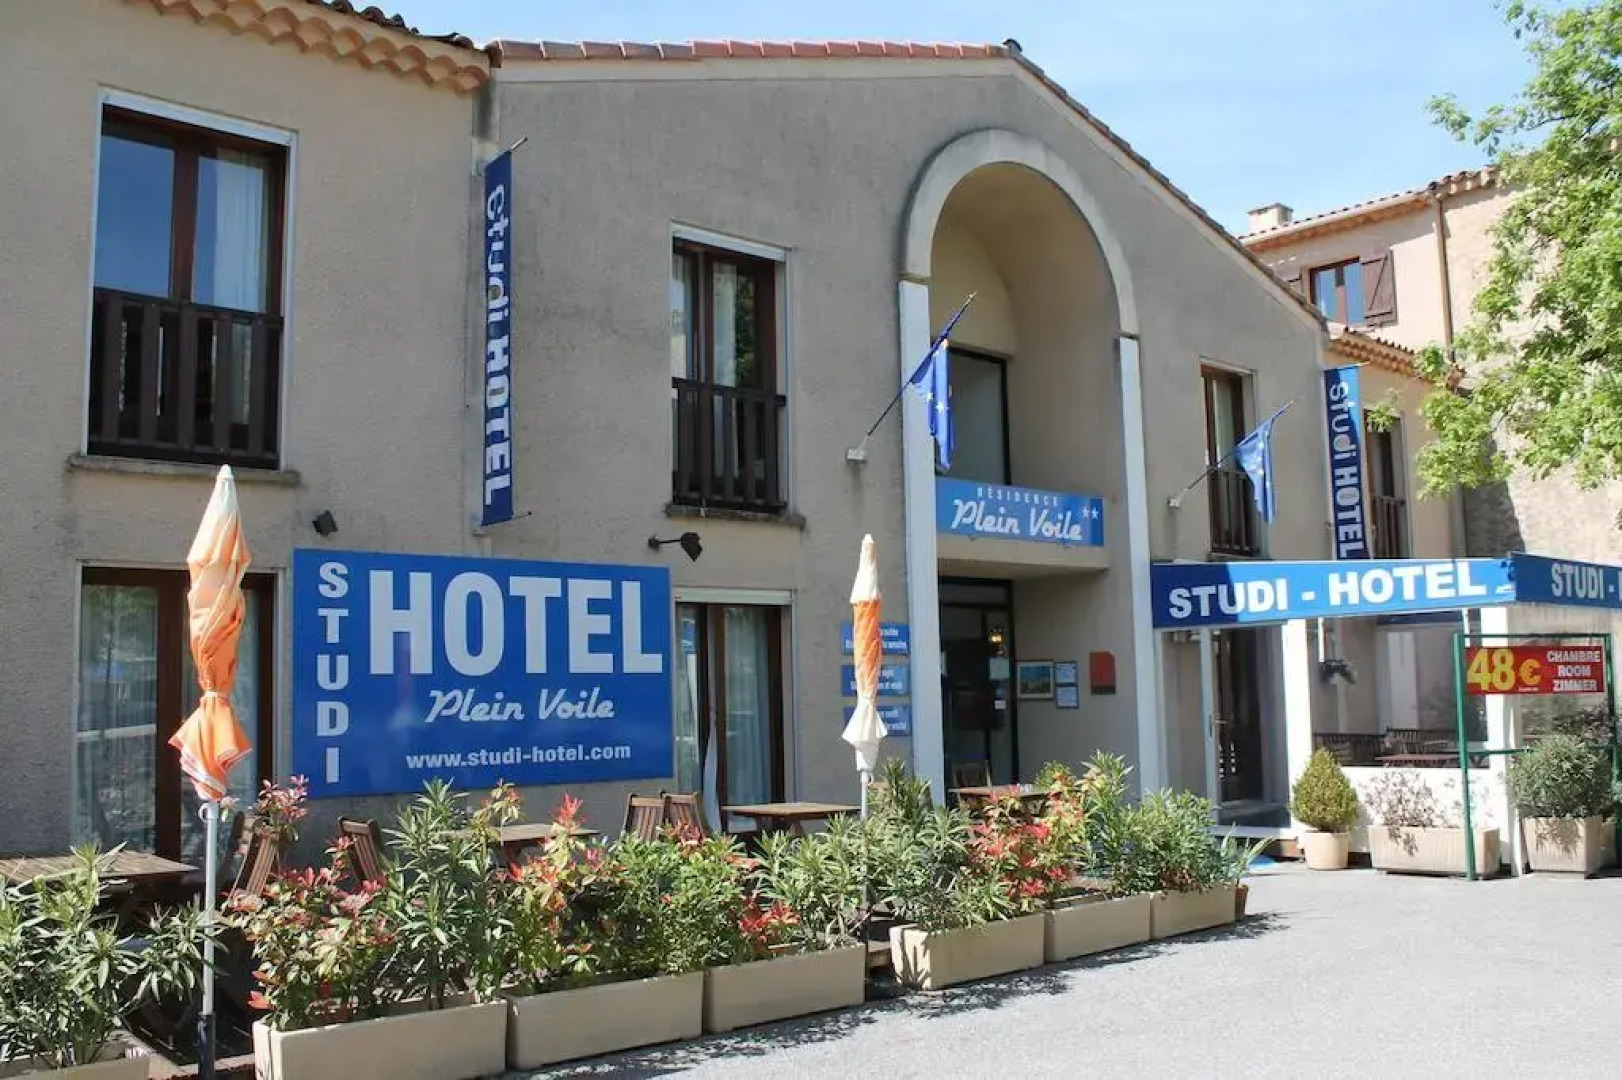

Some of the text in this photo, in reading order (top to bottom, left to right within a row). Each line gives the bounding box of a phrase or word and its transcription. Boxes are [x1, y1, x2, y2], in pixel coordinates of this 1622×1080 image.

[485, 335, 511, 505] HOTEL
[951, 499, 1083, 541] Plein Voile
[1334, 465, 1364, 558] HOTEL
[1168, 578, 1288, 619] STUDI
[1328, 559, 1487, 606] HOTEL
[1551, 563, 1604, 599] STUDI
[368, 569, 663, 677] HOTEL
[316, 561, 350, 783] STUDI
[1467, 648, 1542, 691] 48 €
[1546, 651, 1600, 662] CHAMBRE
[1558, 665, 1591, 676] ROOM
[425, 687, 615, 723] Plein Voile
[1553, 679, 1597, 691] ZIMMER
[406, 742, 631, 769] www.studi-hotel.com
